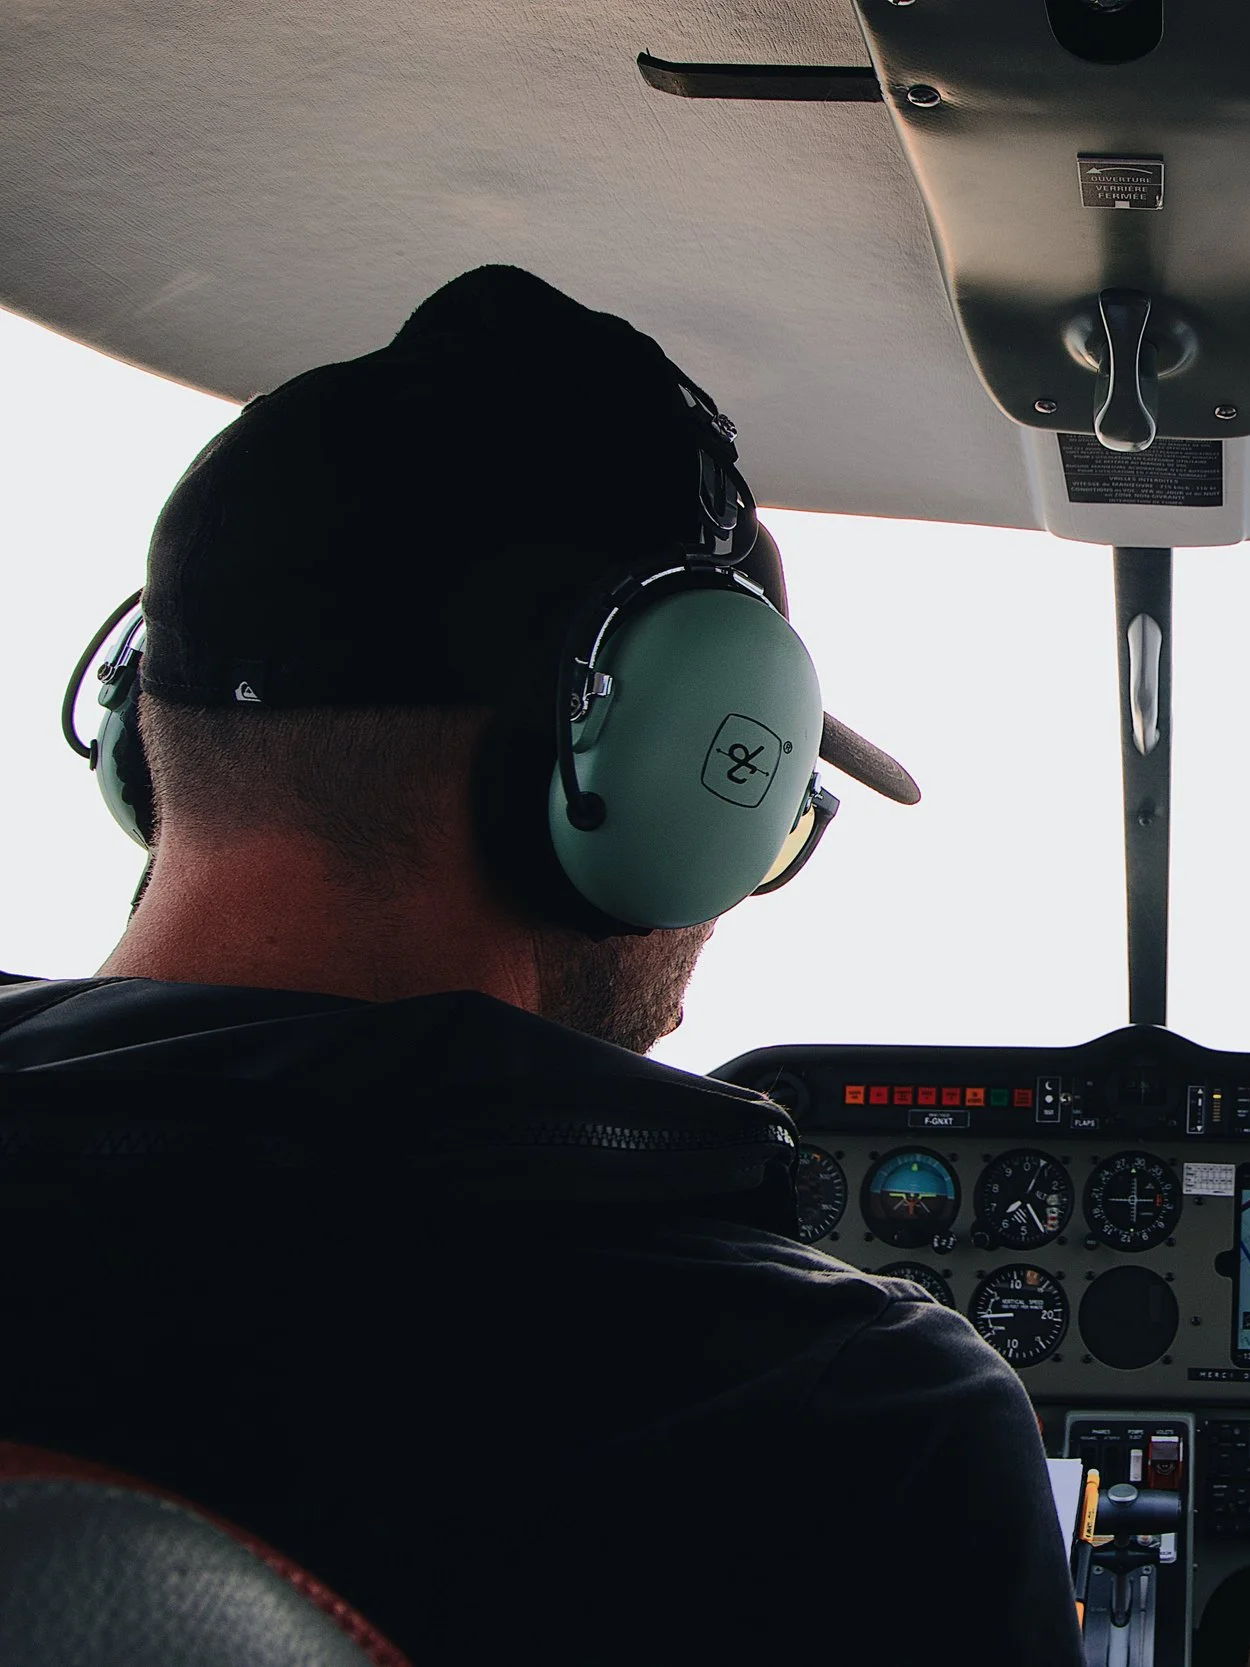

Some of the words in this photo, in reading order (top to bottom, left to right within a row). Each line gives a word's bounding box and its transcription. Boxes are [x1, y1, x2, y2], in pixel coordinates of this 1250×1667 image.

[1098, 192, 1146, 200] FERMÉE
[924, 1117, 954, 1125] F-GNXT
[1134, 1158, 1145, 1166] 30
[1024, 1162, 1031, 1172] 0
[1004, 1168, 1012, 1177] 9
[992, 1184, 1000, 1193] 8
[1052, 1181, 1059, 1190] 2
[990, 1203, 997, 1212] 7
[1002, 1220, 1009, 1228] 6
[1020, 1226, 1028, 1236] 5
[1103, 1224, 1113, 1235] 15
[1120, 1234, 1131, 1243] 12
[1010, 1280, 1022, 1289] 10
[1041, 1310, 1054, 1320] 20
[1007, 1339, 1019, 1348] 10
